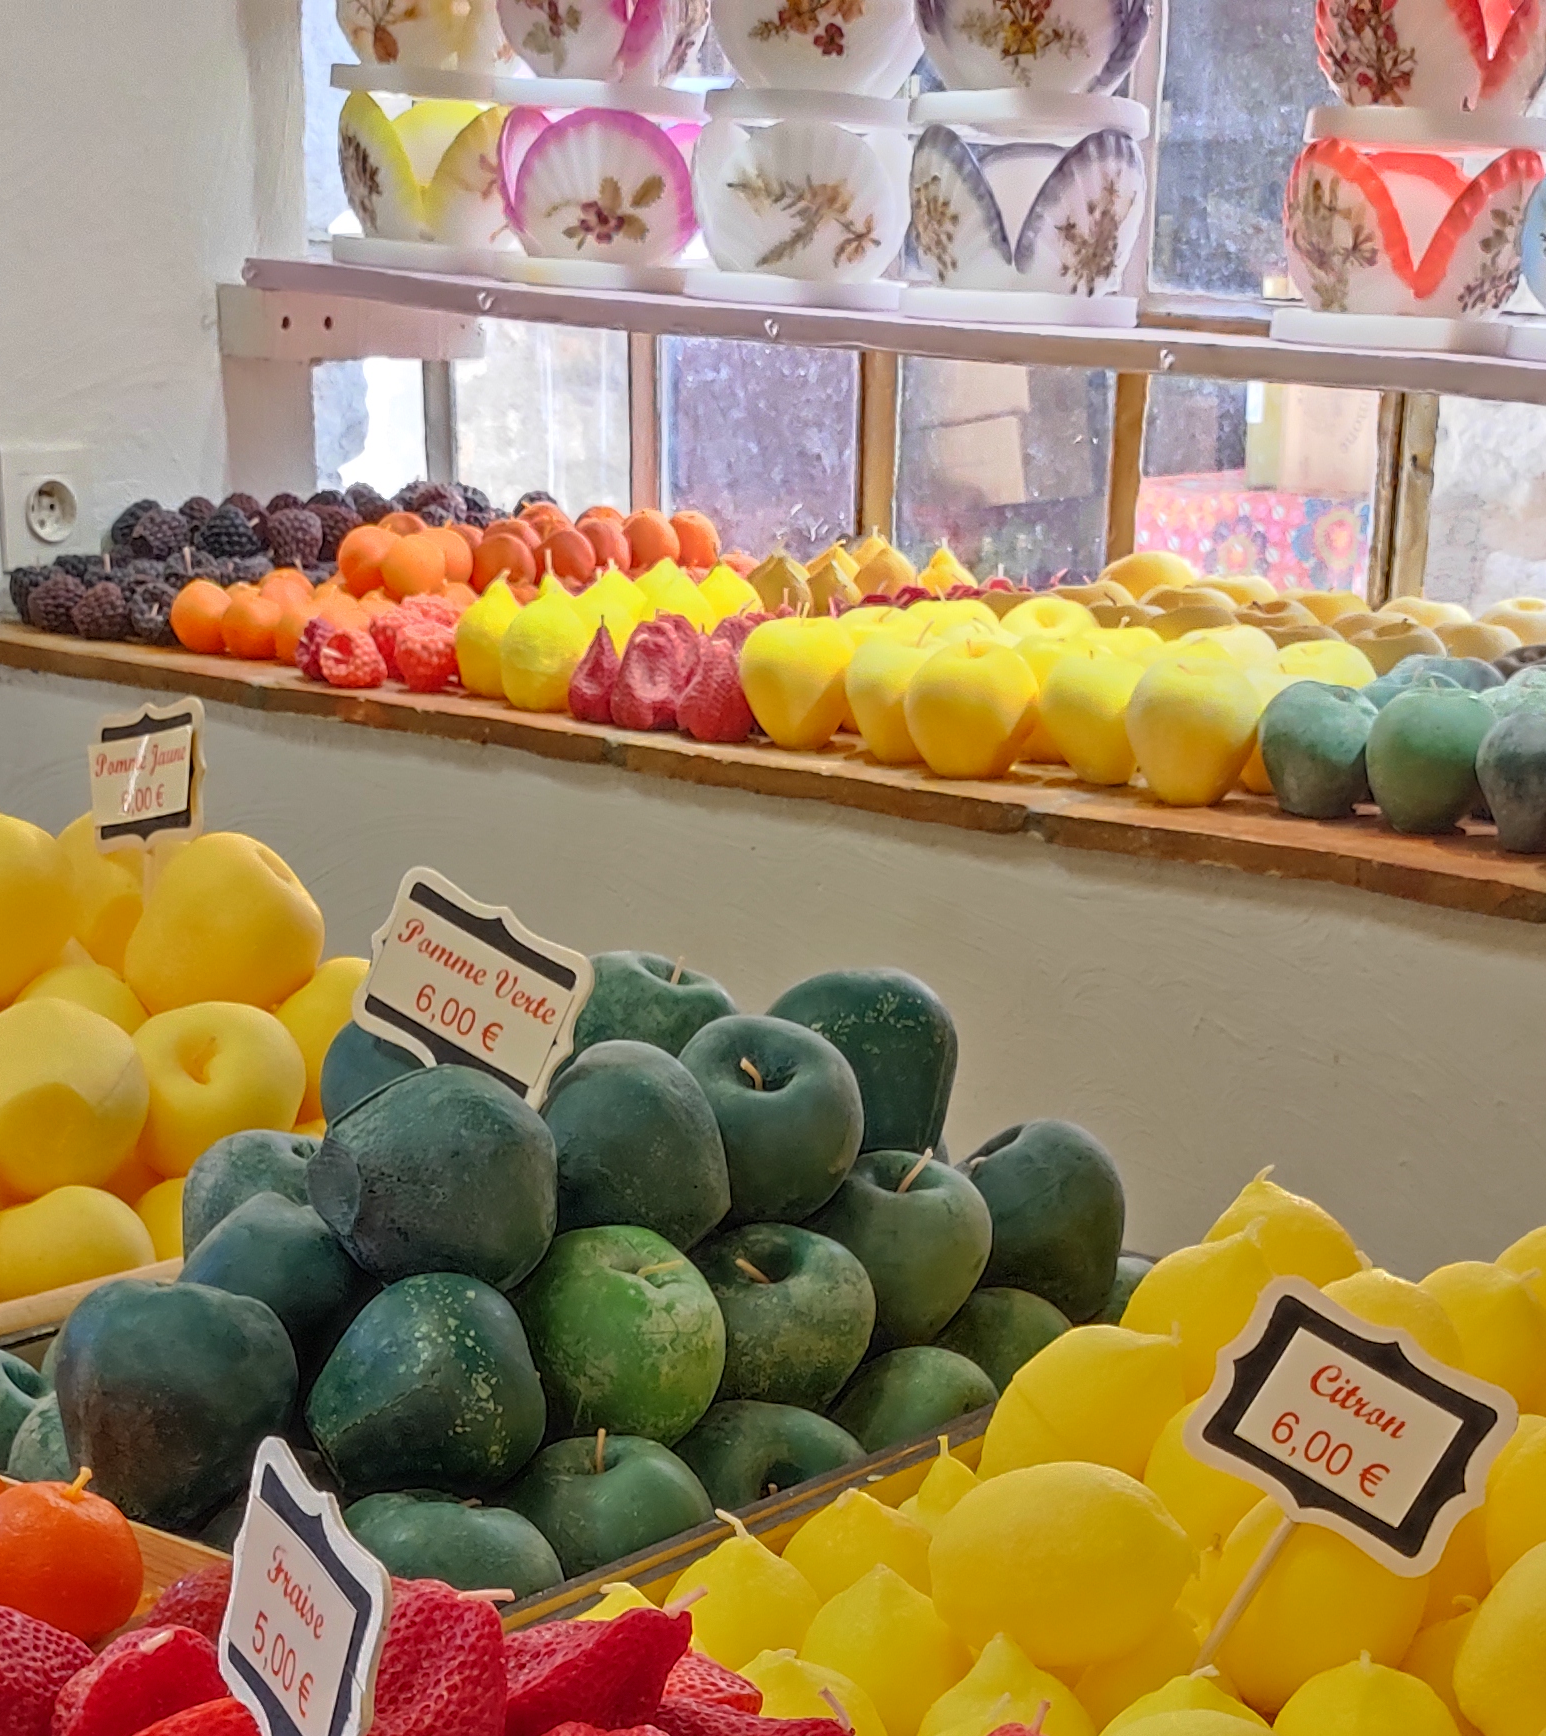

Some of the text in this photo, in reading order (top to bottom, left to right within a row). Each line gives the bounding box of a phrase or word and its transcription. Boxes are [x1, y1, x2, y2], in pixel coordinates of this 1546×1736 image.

[156, 783, 164, 807] €
[396, 918, 557, 1026] Pomme Verte
[415, 984, 504, 1053] 6,00 €
[1310, 1364, 1407, 1440] Citron
[1271, 1411, 1391, 1498] 6,00 €
[266, 1544, 326, 1641] Fraise
[252, 1610, 315, 1720] 5,00 €
